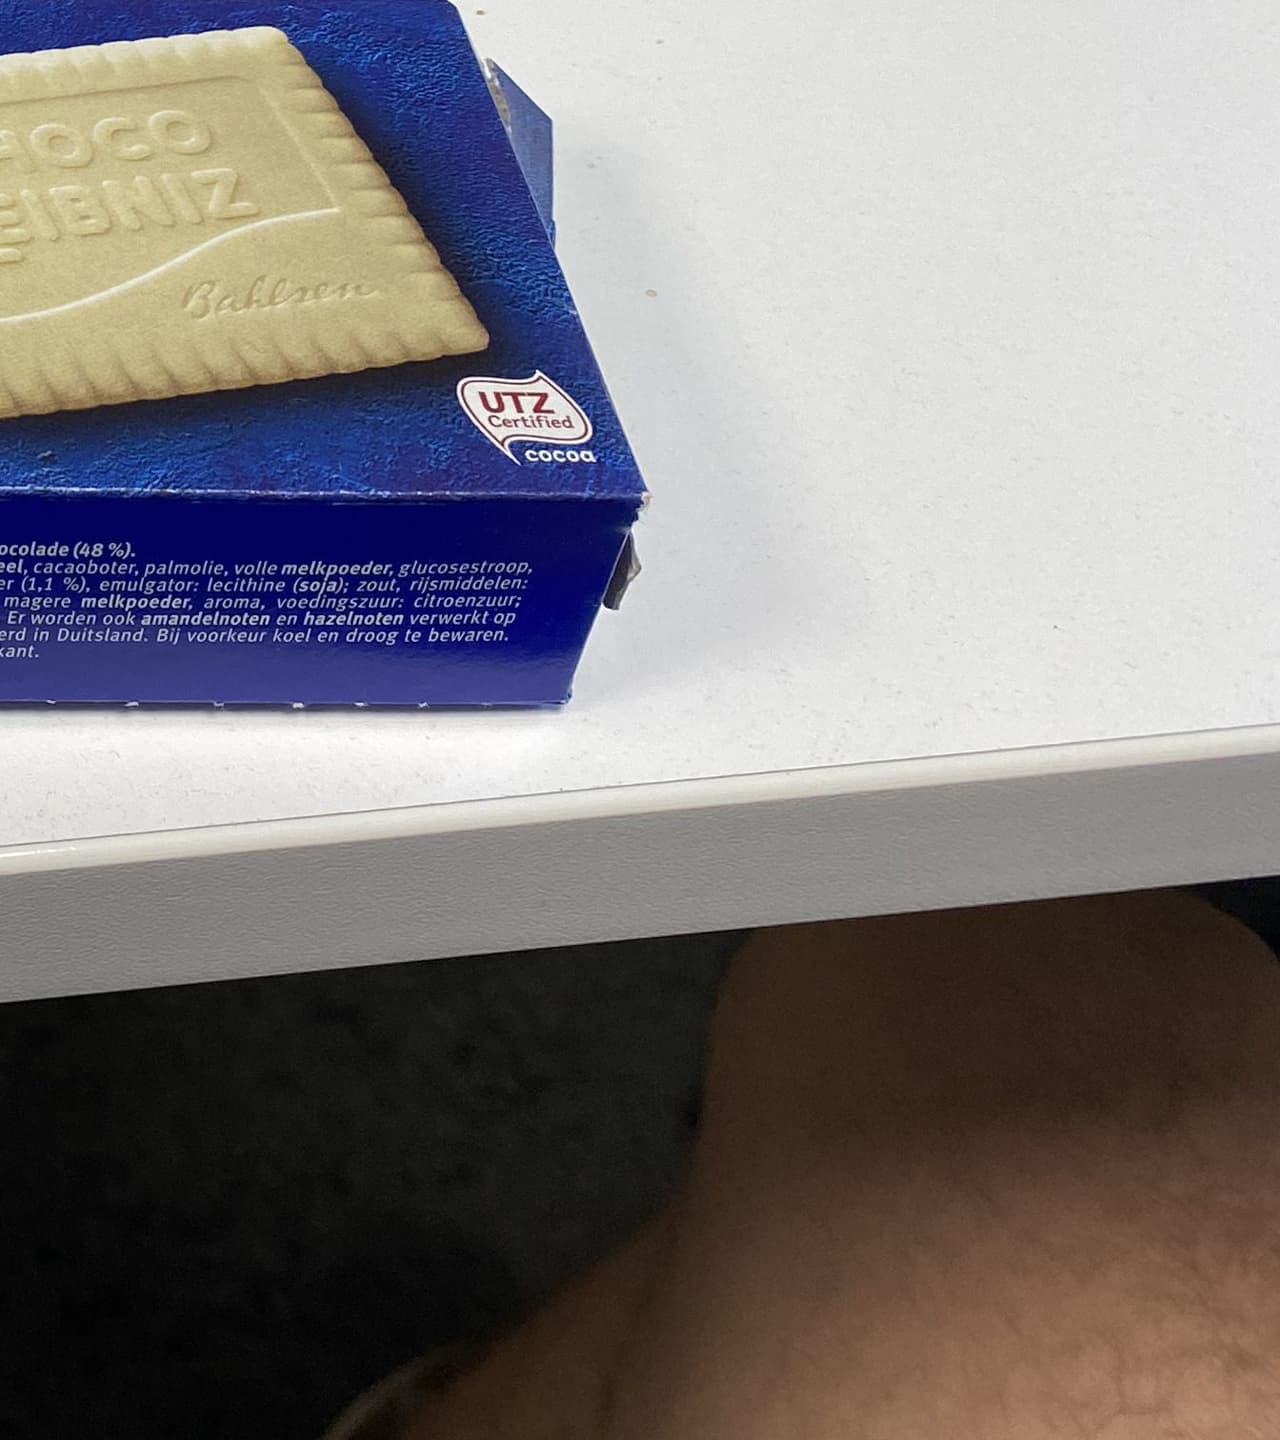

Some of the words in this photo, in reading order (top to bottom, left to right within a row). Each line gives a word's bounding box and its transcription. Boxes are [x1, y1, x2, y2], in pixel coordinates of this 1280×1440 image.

[180, 268, 380, 322] Bahlsen
[478, 391, 555, 414] UTZ
[488, 414, 575, 429] Certified
[524, 449, 597, 463] cocoa
[71, 542, 103, 559] (48
[106, 543, 136, 560] %).
[32, 559, 140, 577] cacaoboter,
[143, 560, 229, 579] palmolie,
[232, 561, 277, 575] volle
[279, 560, 394, 579] melkpoeder,
[397, 559, 533, 578] glucosestroop,
[19, 576, 52, 594] (1,1
[60, 577, 91, 594] %),
[98, 577, 199, 596] emulgator:
[206, 578, 285, 592] lecithine
[291, 577, 349, 596] (soja);
[355, 577, 401, 594] zout,
[408, 575, 528, 595] rijsmiddelen:
[32, 627, 49, 642] in
[56, 627, 149, 642] Duitsland.
[155, 628, 179, 646] Bij
[186, 628, 266, 642] voorkeur
[272, 628, 310, 642] koel
[316, 631, 338, 642] en
[344, 627, 398, 646] droog
[404, 627, 421, 642] te
[427, 626, 509, 642] bewaren.
